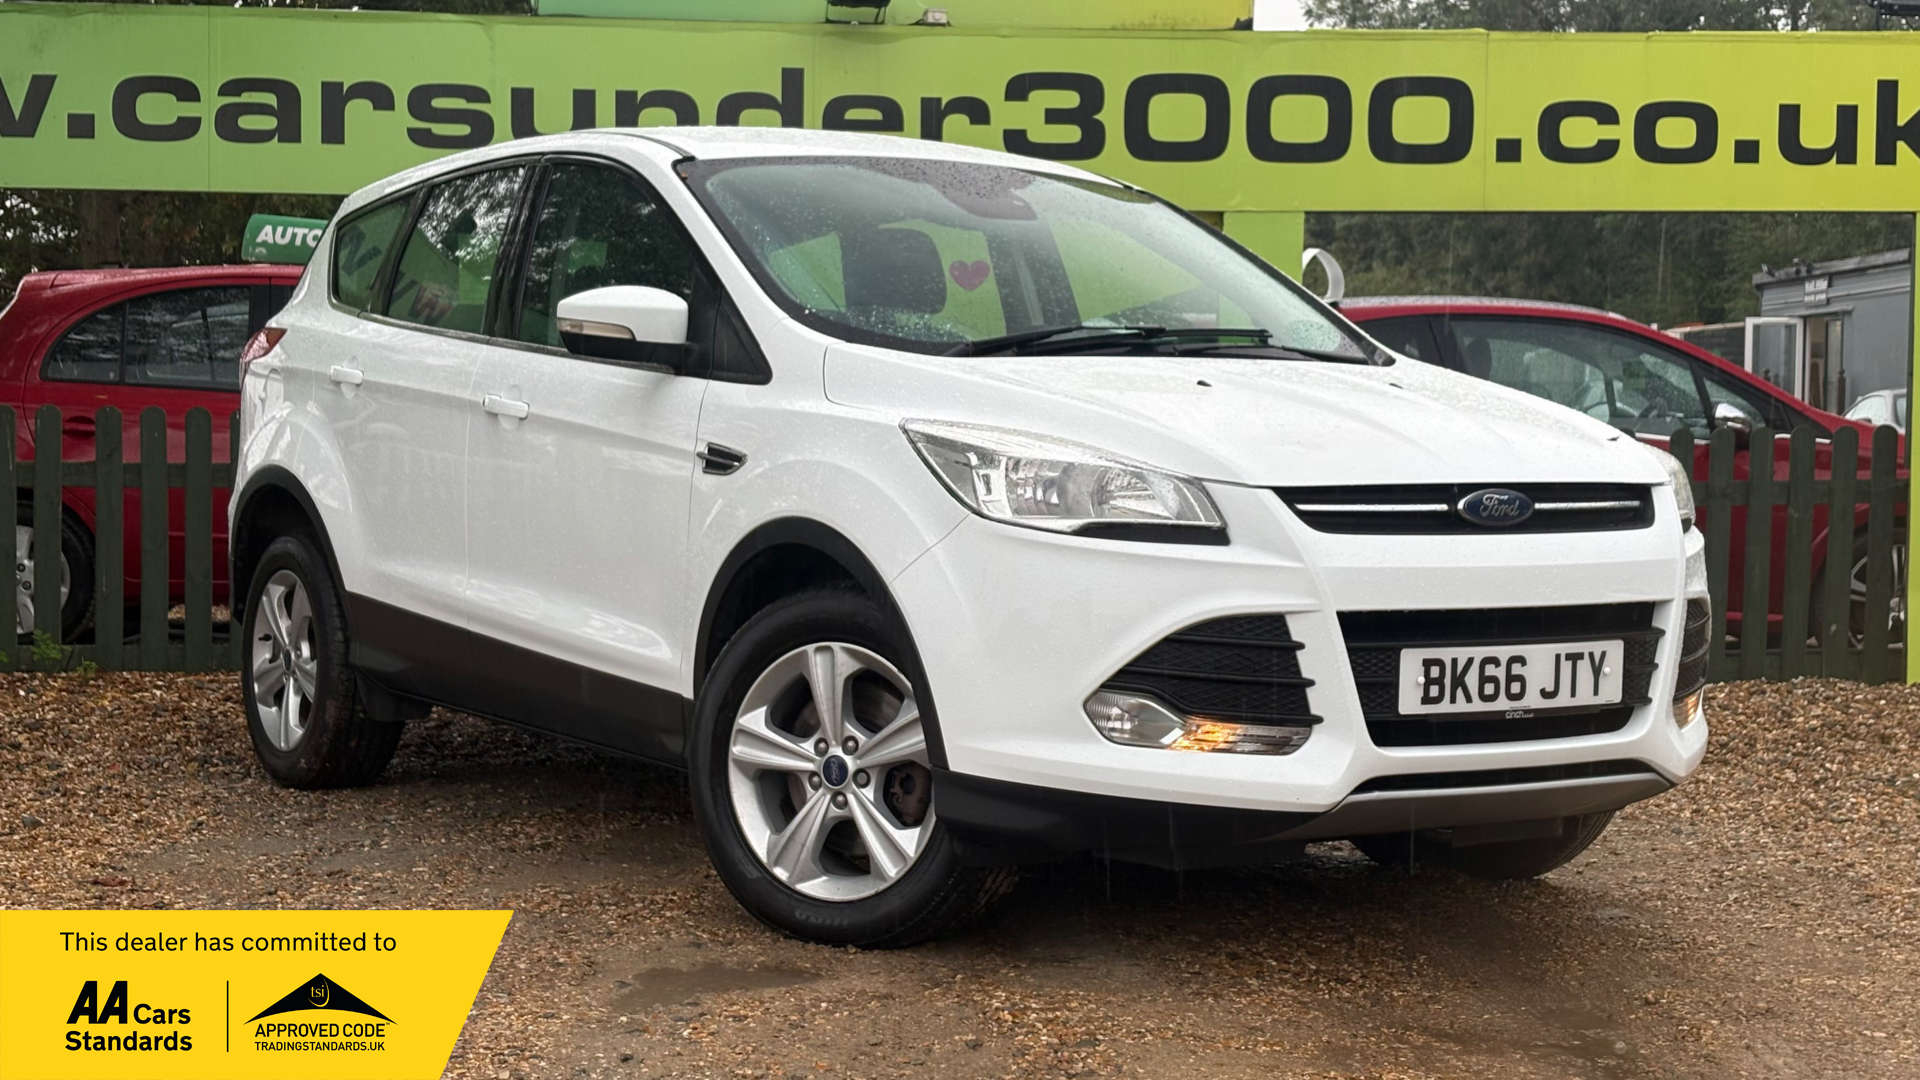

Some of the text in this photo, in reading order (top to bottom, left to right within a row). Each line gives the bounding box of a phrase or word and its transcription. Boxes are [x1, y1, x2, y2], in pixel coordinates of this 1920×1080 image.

[255, 224, 324, 248] AUTO
[1480, 493, 1520, 517] Ford
[1420, 650, 1607, 705] BK66 JTY
